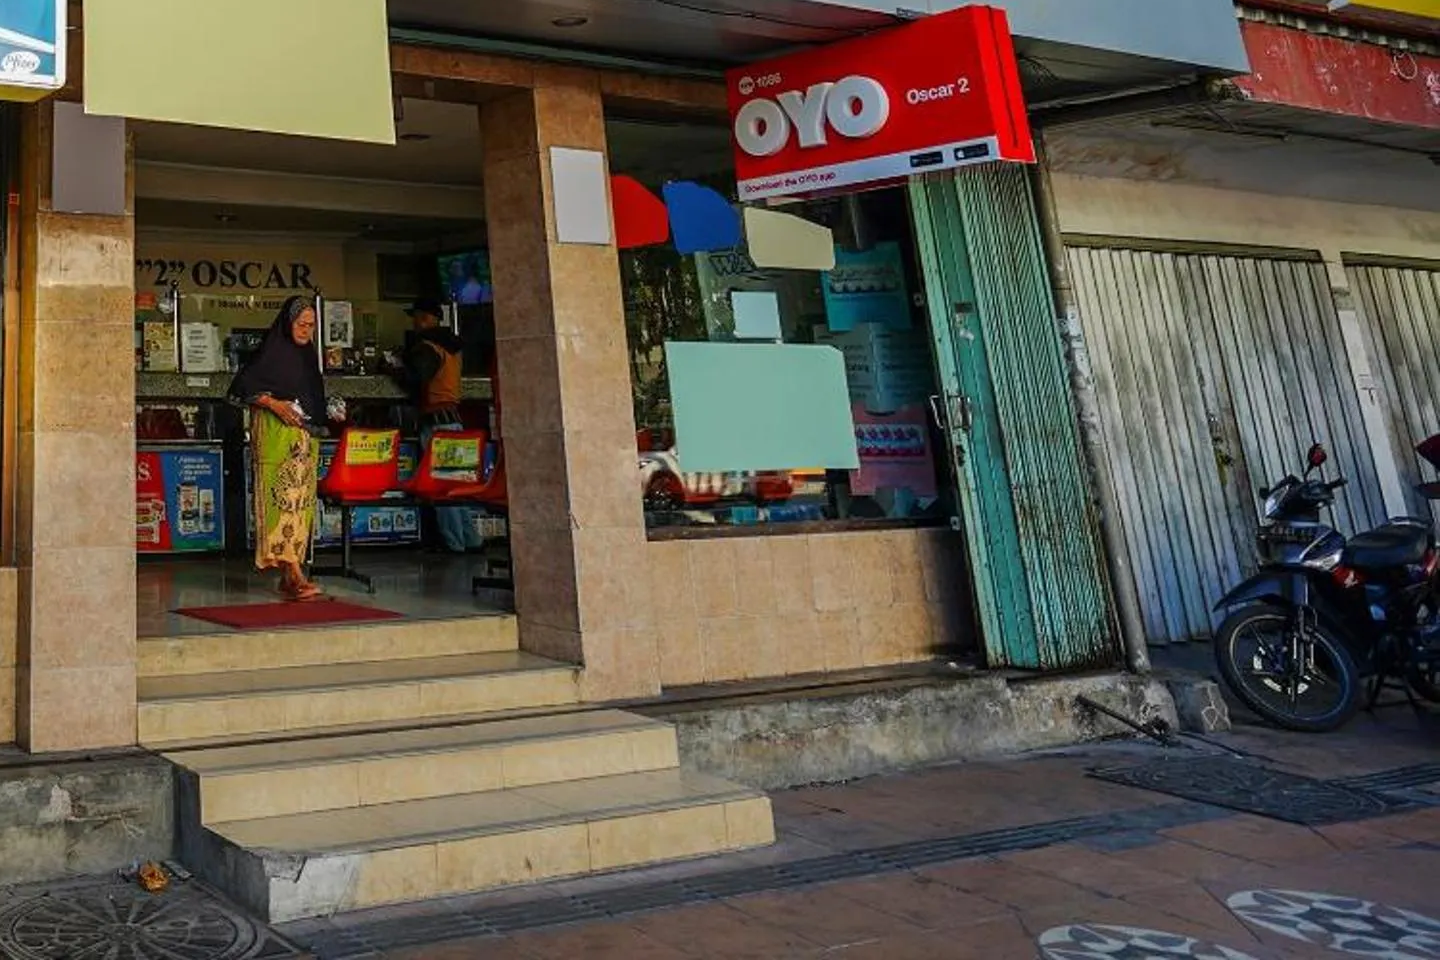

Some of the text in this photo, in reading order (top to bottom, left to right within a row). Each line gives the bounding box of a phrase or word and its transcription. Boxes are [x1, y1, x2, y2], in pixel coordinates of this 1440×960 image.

[907, 77, 971, 105] Oscar 2
[735, 75, 890, 157] OYO
[192, 260, 316, 291] OSCAR
